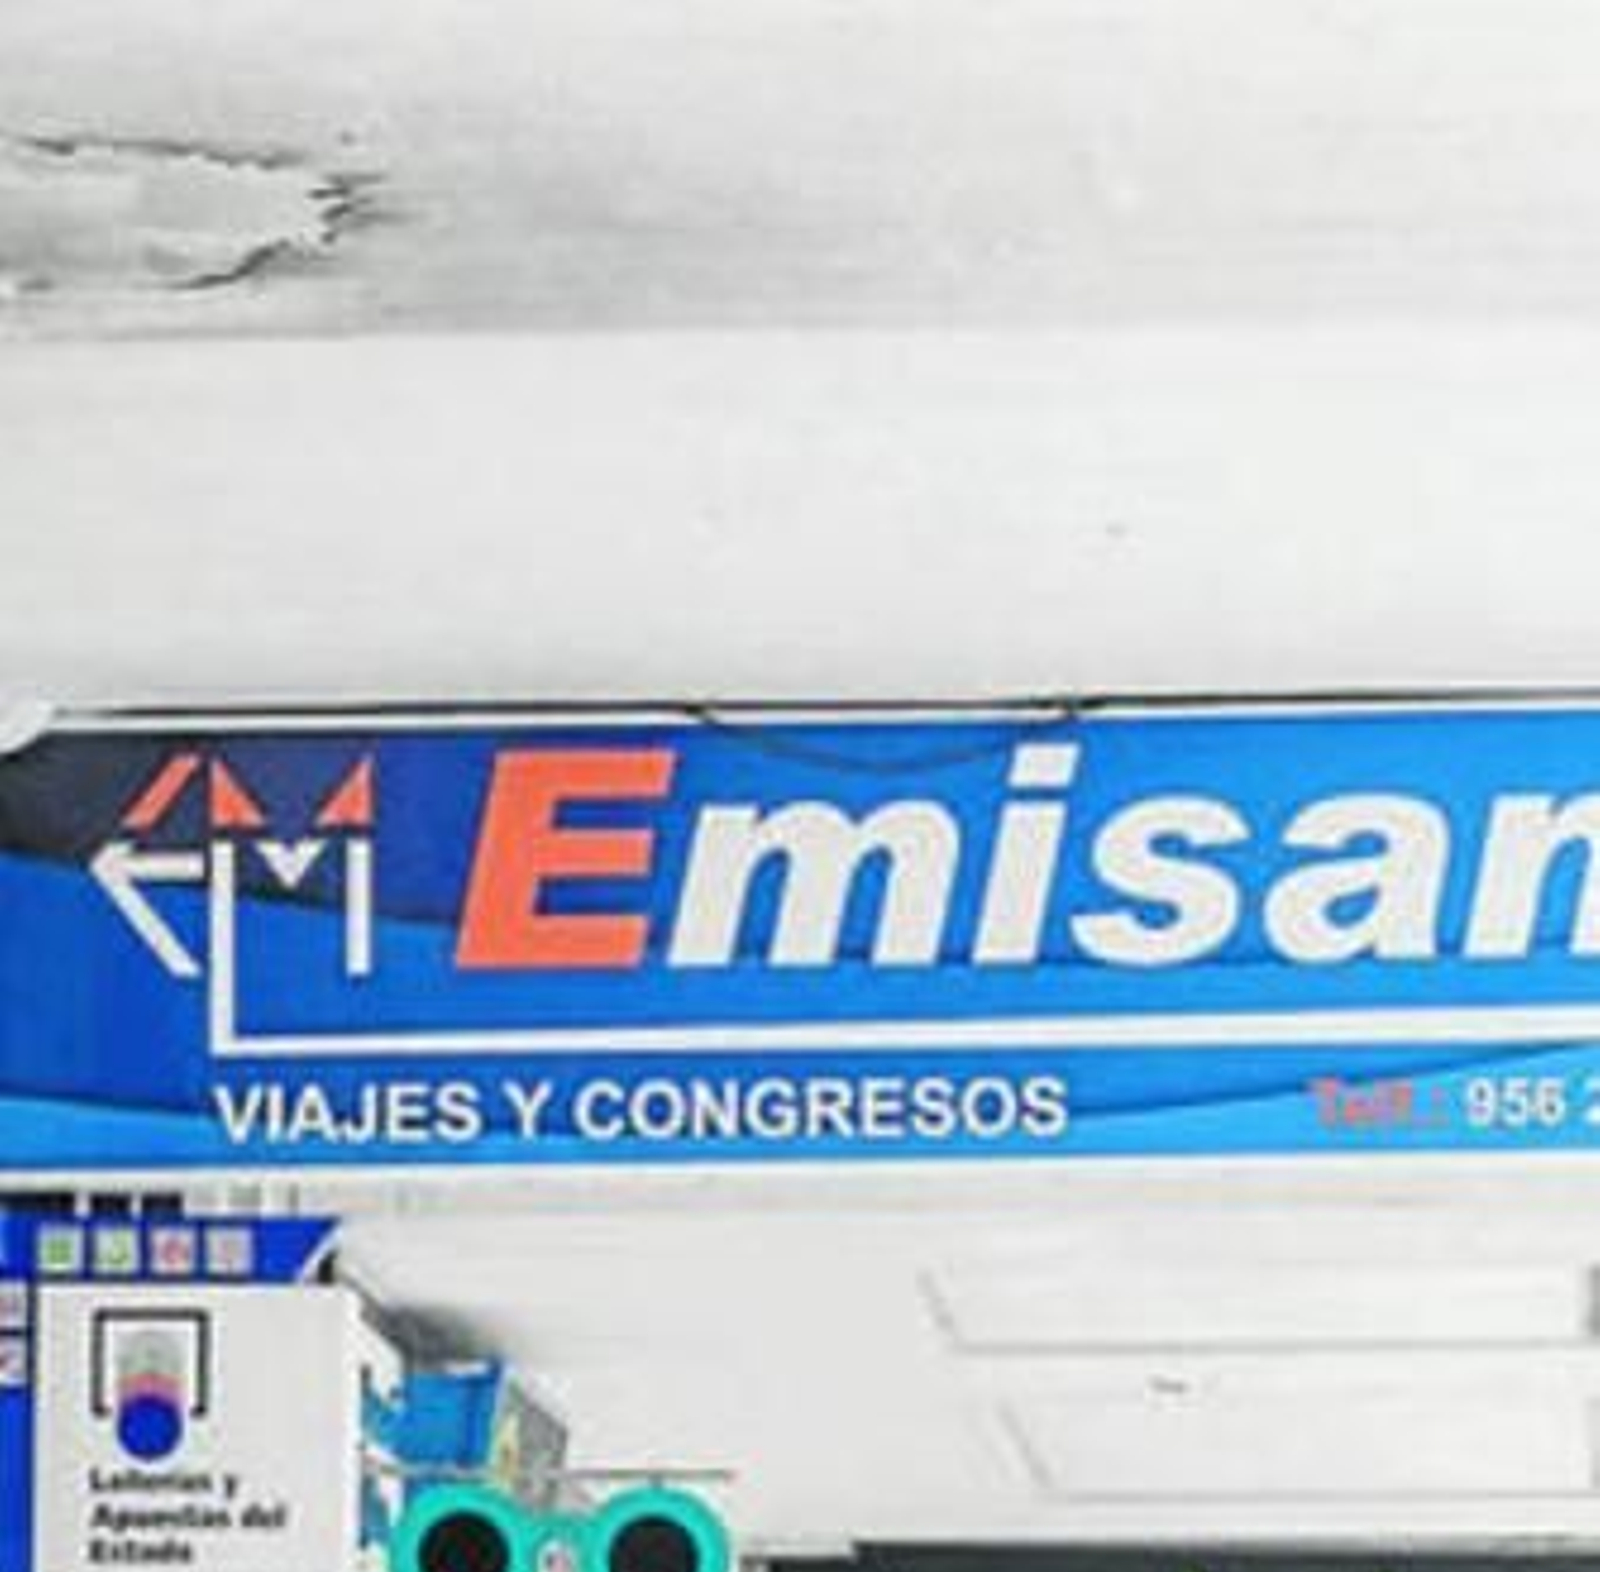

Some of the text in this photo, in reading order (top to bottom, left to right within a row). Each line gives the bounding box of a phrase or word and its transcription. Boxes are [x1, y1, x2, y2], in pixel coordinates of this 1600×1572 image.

[214, 1075, 1068, 1145] VIAJES Y CONGRESOS
[1464, 1076, 1566, 1127] 956
